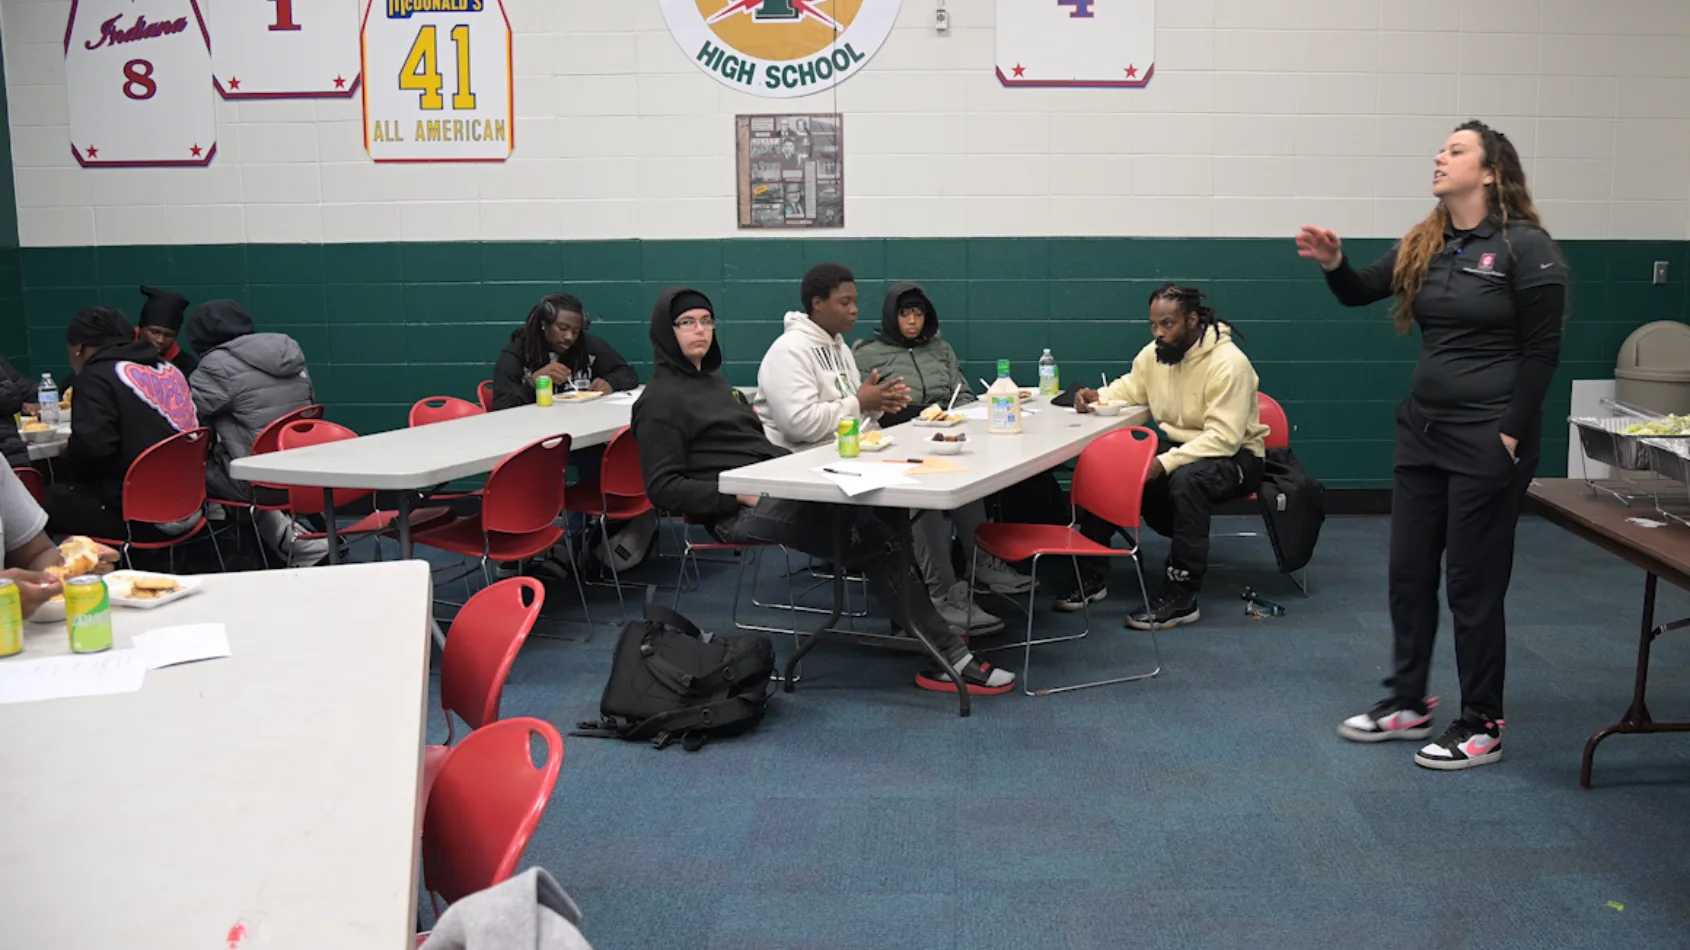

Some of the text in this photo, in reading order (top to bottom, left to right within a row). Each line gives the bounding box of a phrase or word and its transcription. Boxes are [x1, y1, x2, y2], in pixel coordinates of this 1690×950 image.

[84, 13, 188, 50] Indiana
[123, 59, 157, 100] 8
[398, 24, 476, 110] 41
[696, 40, 865, 89] HIGH SCHOOL
[373, 119, 506, 142] ALL AMERICAN
